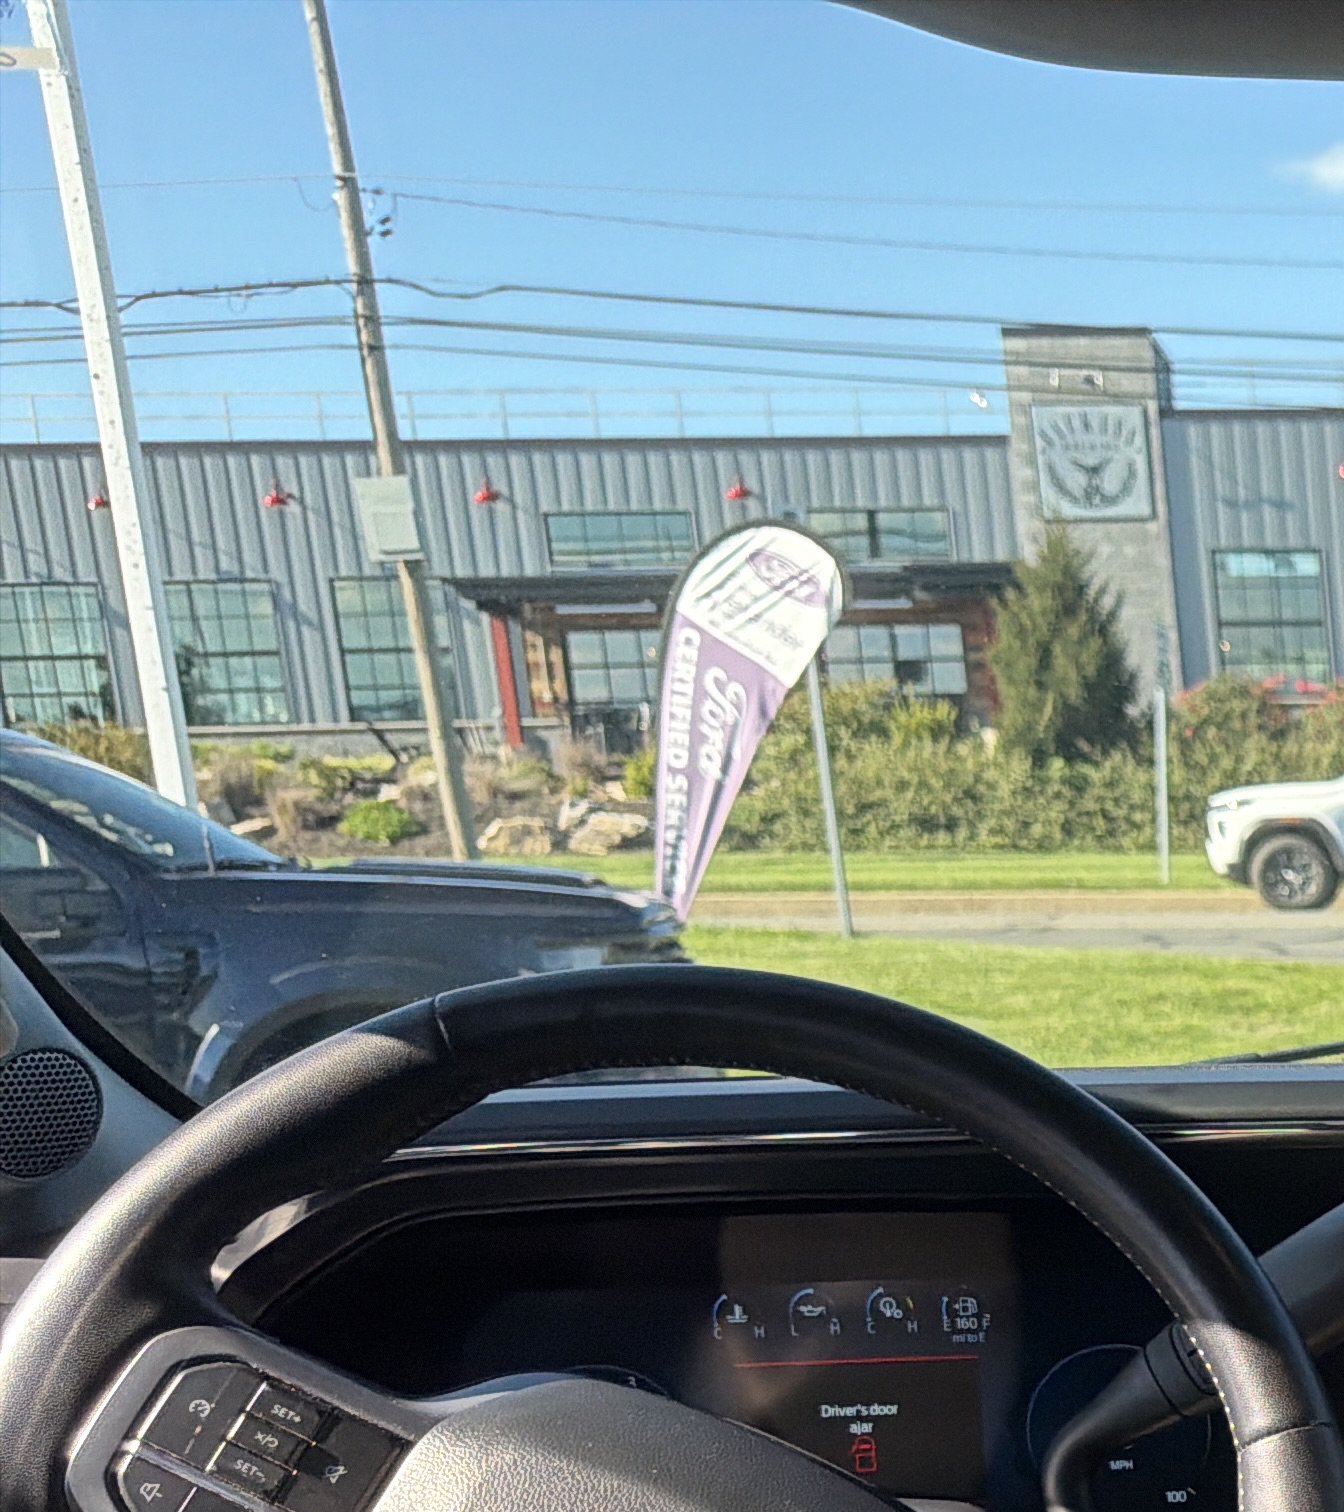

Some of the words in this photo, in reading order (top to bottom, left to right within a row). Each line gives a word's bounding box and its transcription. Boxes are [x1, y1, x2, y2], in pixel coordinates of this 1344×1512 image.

[667, 627, 701, 770] CERTIFIED
[820, 1403, 868, 1418] Driver's
[869, 1402, 899, 1416] door
[849, 1420, 874, 1436] ajar
[1109, 1459, 1134, 1471] MPH
[1165, 1490, 1188, 1503] 100
